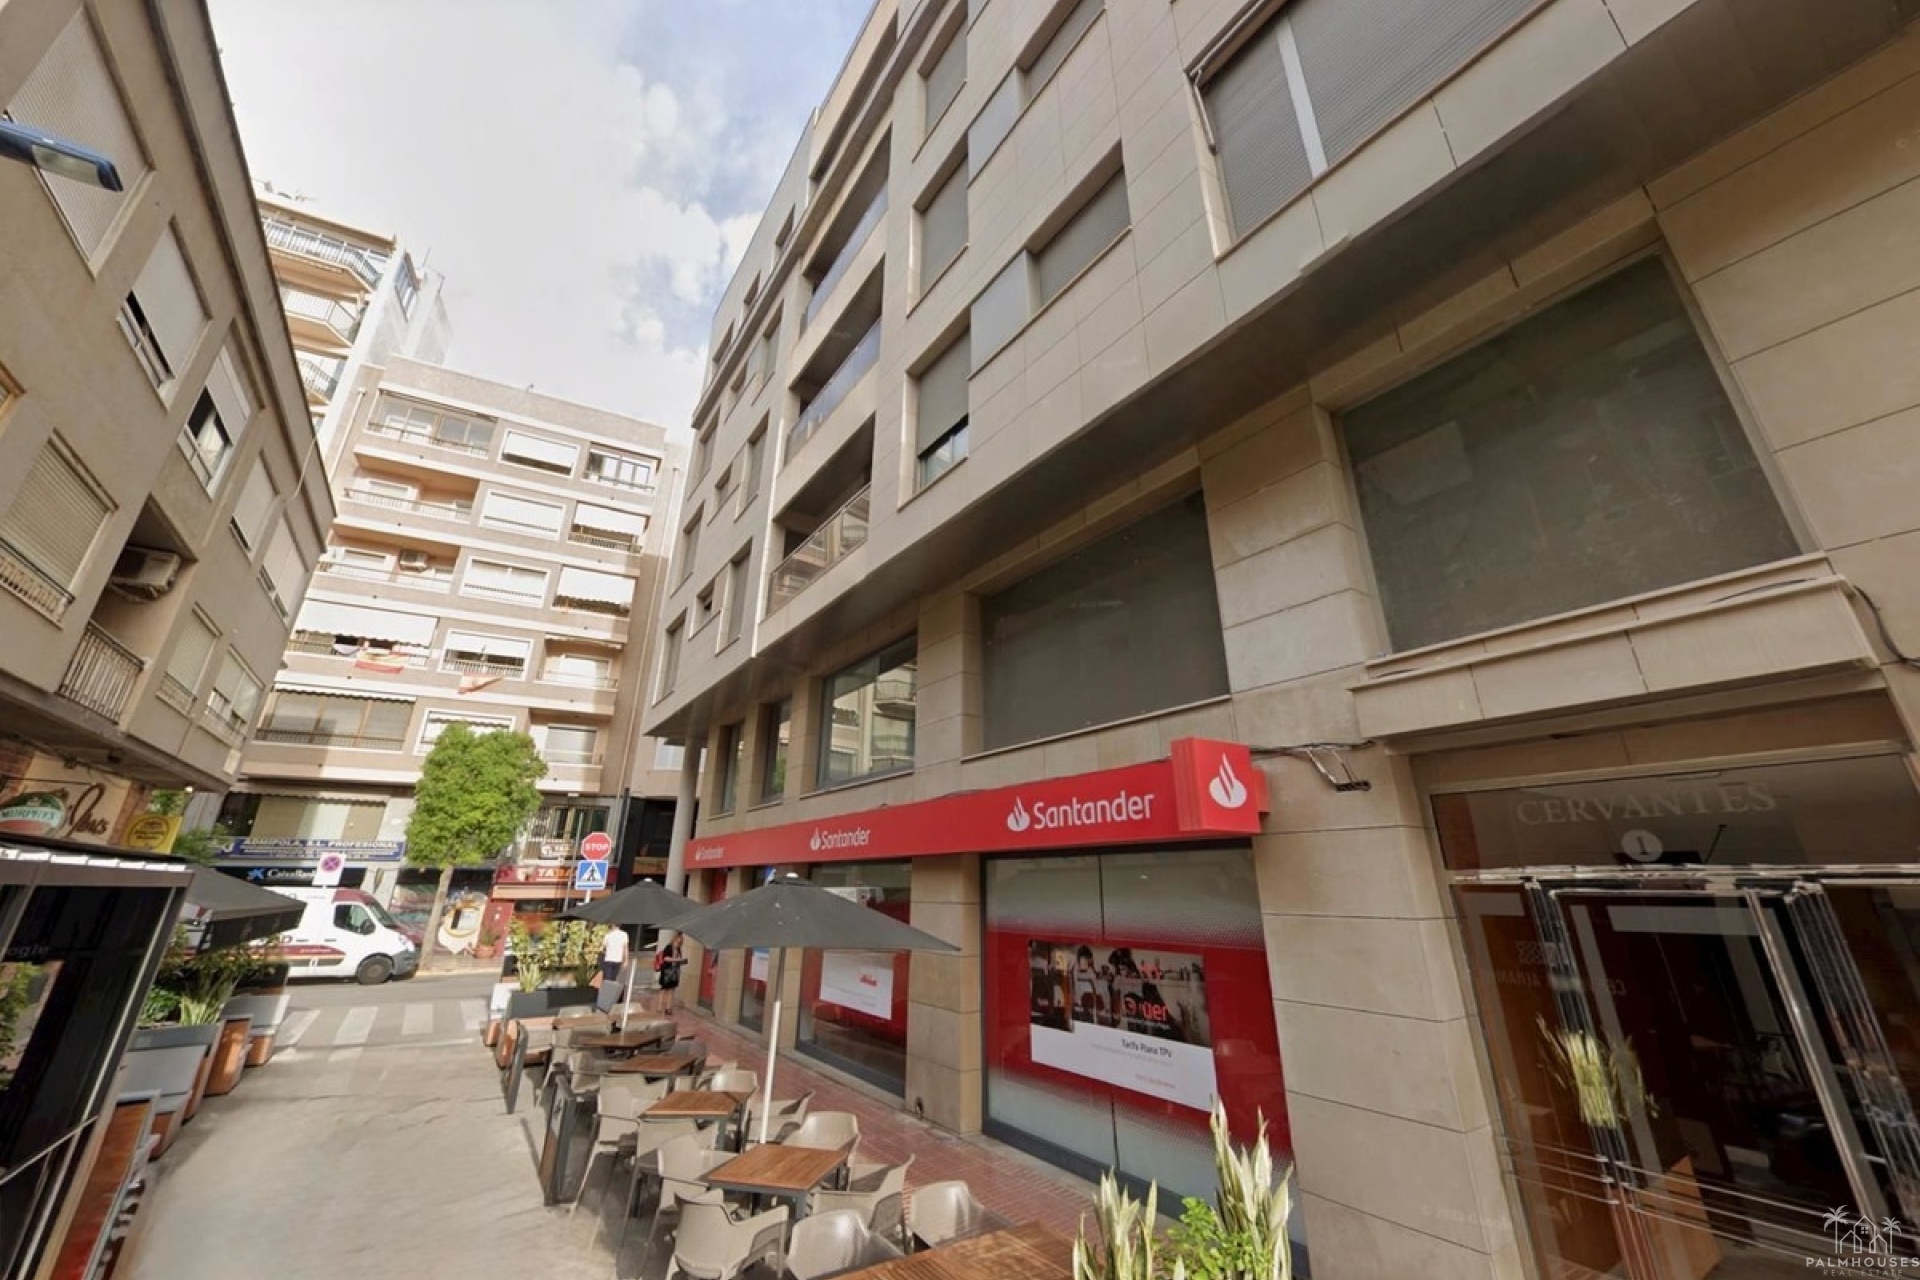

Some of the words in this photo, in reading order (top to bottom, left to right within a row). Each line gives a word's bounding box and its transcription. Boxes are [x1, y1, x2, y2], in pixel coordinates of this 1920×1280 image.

[1033, 790, 1155, 829] Santander
[1515, 781, 1777, 825] CERVANTES
[585, 843, 609, 852] STOP
[821, 827, 871, 850] Santander
